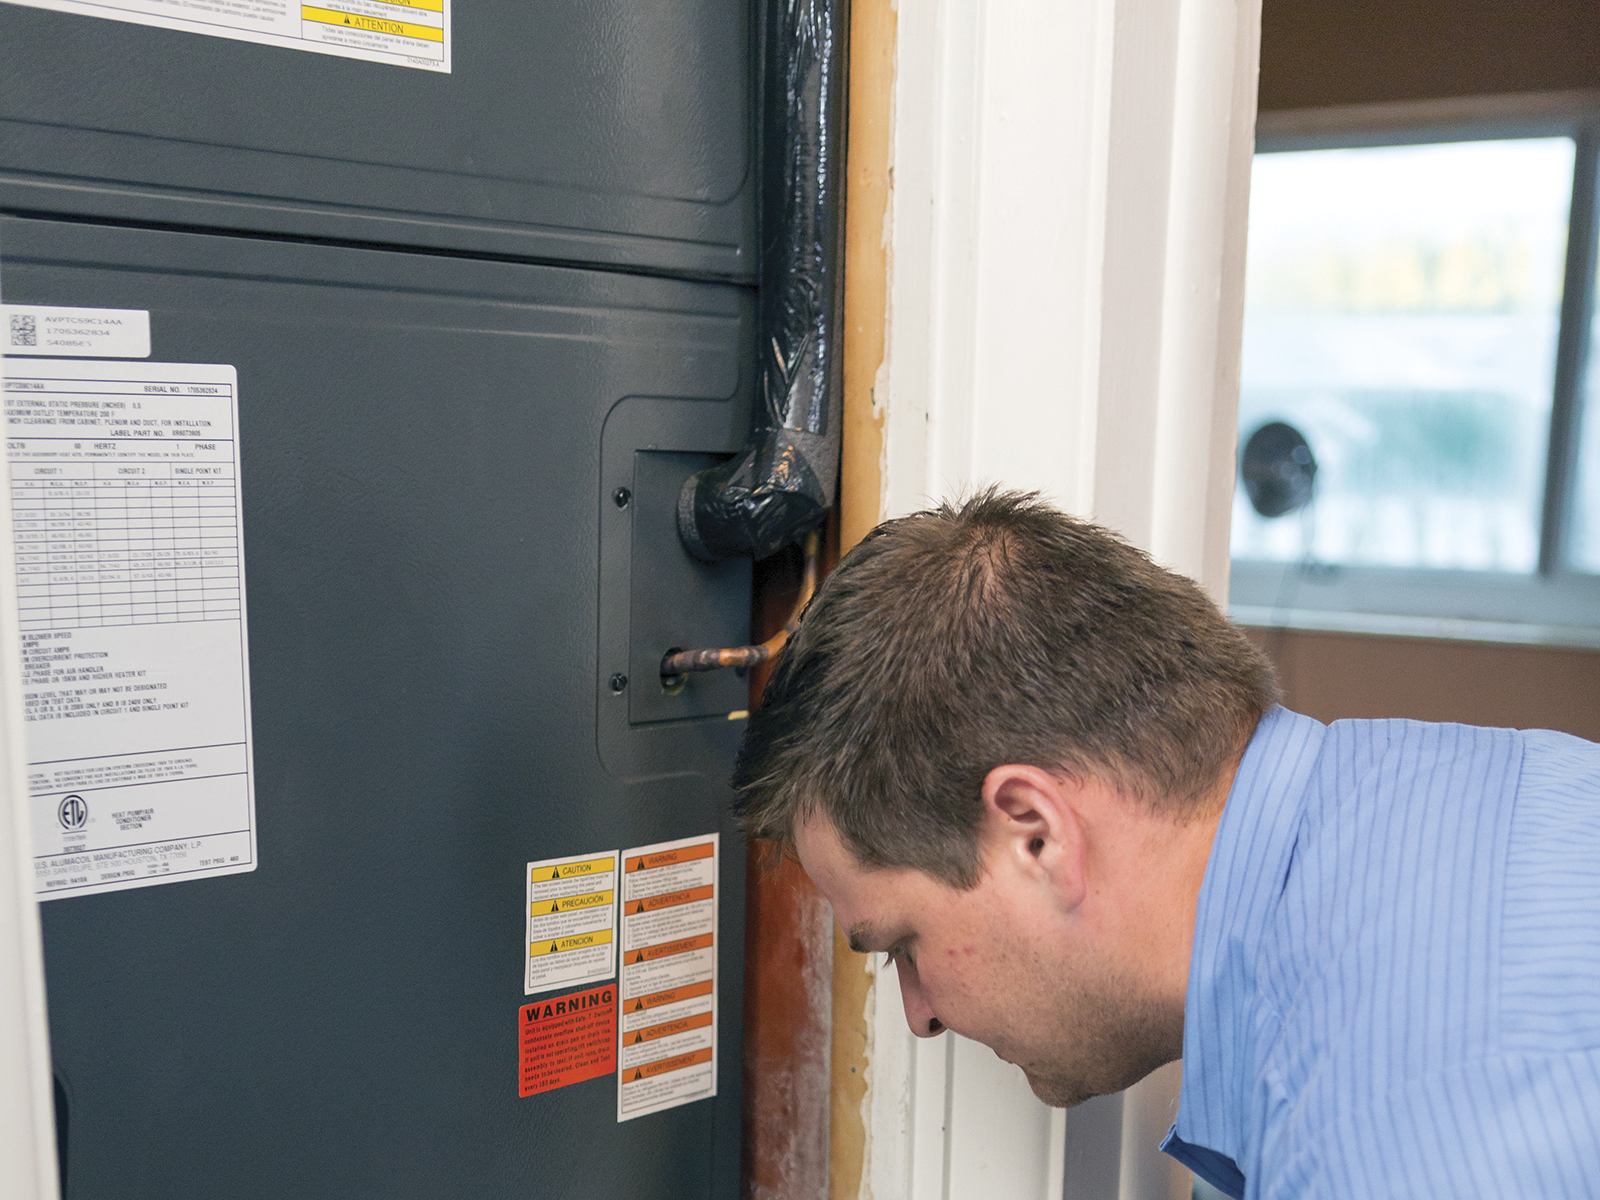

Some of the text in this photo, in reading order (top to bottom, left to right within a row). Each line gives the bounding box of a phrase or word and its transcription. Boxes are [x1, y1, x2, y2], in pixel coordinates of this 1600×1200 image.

[354, 18, 404, 34] ATTENTION
[144, 385, 167, 393] SERIAL
[16, 400, 47, 408] EXTERNAL
[48, 400, 68, 408] STATIC
[70, 401, 99, 409] PRESSURE
[33, 409, 55, 417] OUTLET
[56, 410, 98, 418] TEMPERATURE
[59, 418, 75, 426] FROM
[110, 429, 131, 437] LABEL
[94, 442, 116, 450] HERTZ
[54, 631, 72, 639] SPEED
[74, 651, 108, 660] PROTECTION
[78, 665, 104, 673] HANDLER
[92, 672, 113, 681] HIGHER
[133, 682, 167, 691] DESIGNATED
[115, 815, 152, 825] CONDITIONER
[120, 822, 143, 831] SECTION
[50, 855, 91, 868] ALUMACOIL
[93, 847, 153, 862] MANUFACTURING
[154, 842, 190, 855] COMPANY,
[647, 852, 677, 865] WARNING
[52, 867, 66, 876] SAN
[123, 855, 158, 866] HOUSTON,
[199, 858, 211, 866] TEST
[562, 864, 592, 875] CAUTION
[561, 893, 604, 909] PRECAUCIÓN
[560, 935, 594, 949] ATENCION
[645, 992, 676, 1006] WARNING
[526, 990, 612, 1022] WARNING
[542, 1020, 564, 1032] equipped
[525, 1034, 552, 1046] condensate
